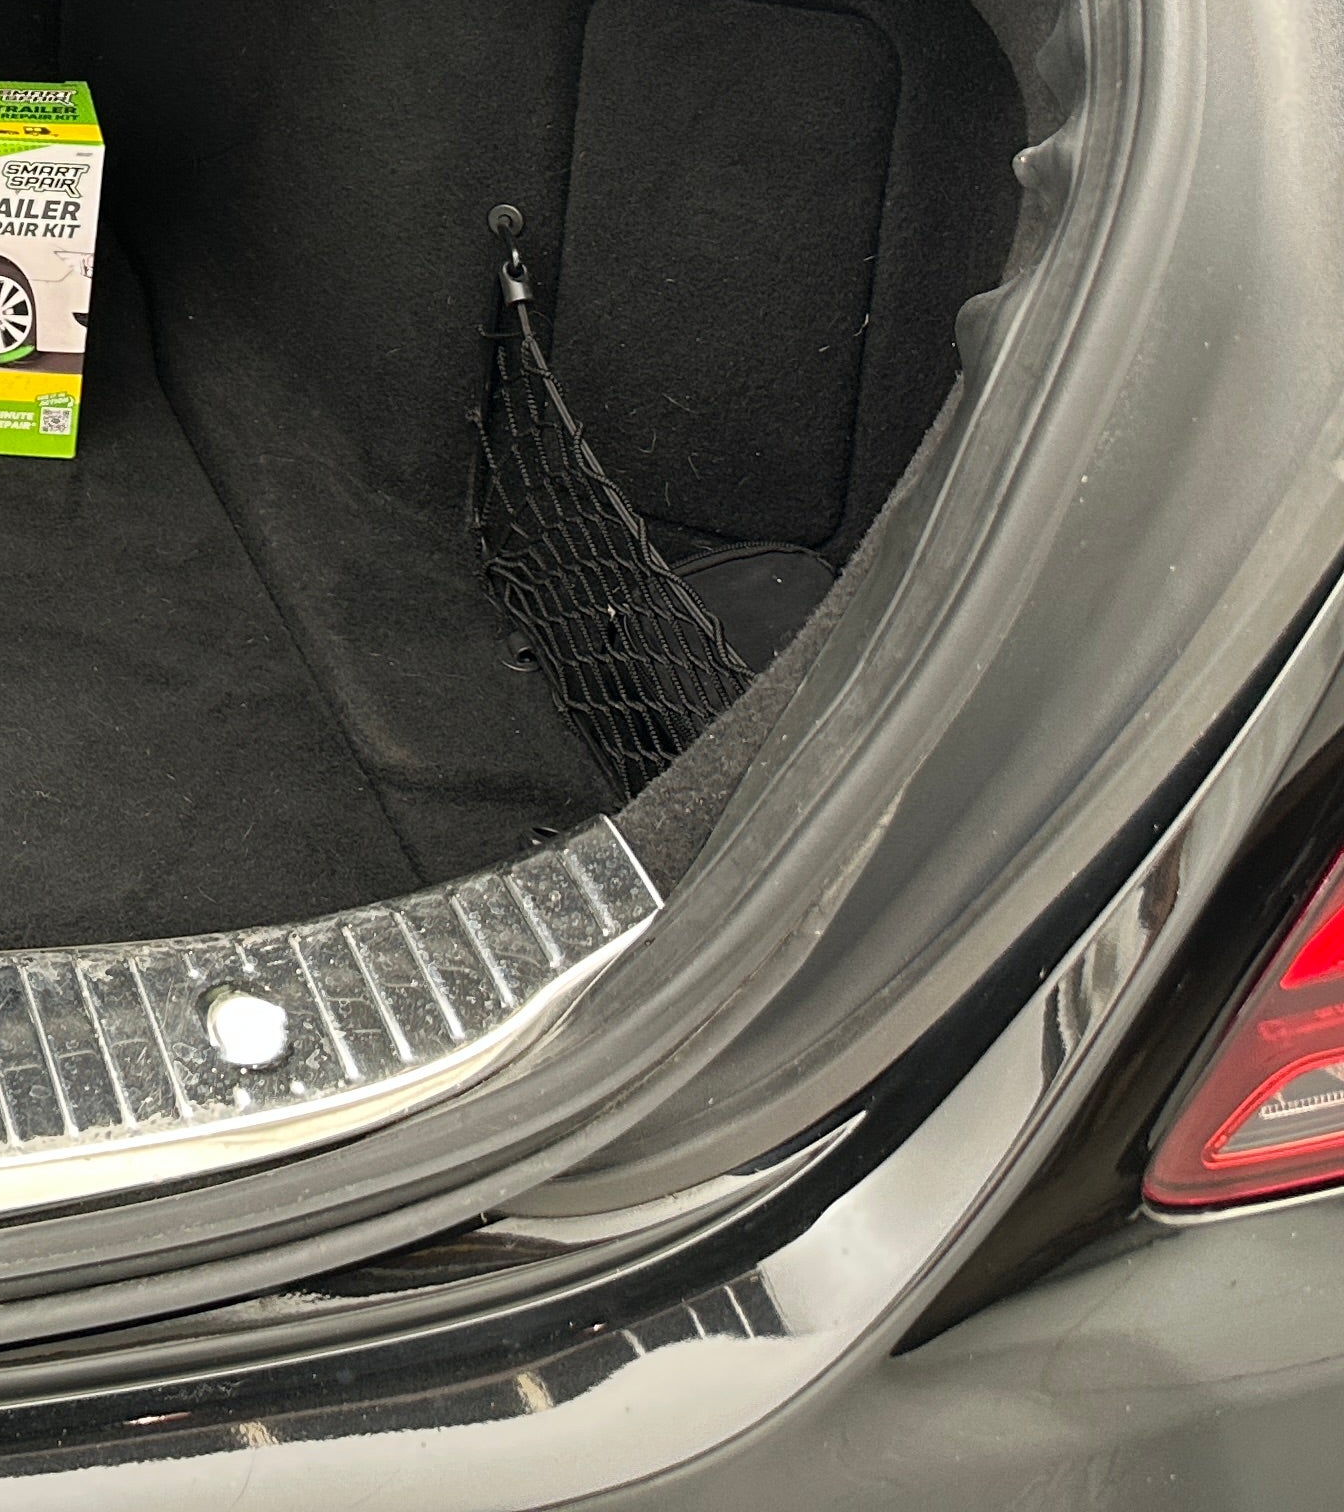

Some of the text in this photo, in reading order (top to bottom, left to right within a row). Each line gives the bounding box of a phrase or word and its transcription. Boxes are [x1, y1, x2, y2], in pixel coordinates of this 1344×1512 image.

[6, 164, 86, 178] SMART
[10, 177, 80, 197] SPAIR
[41, 223, 80, 238] KIT
